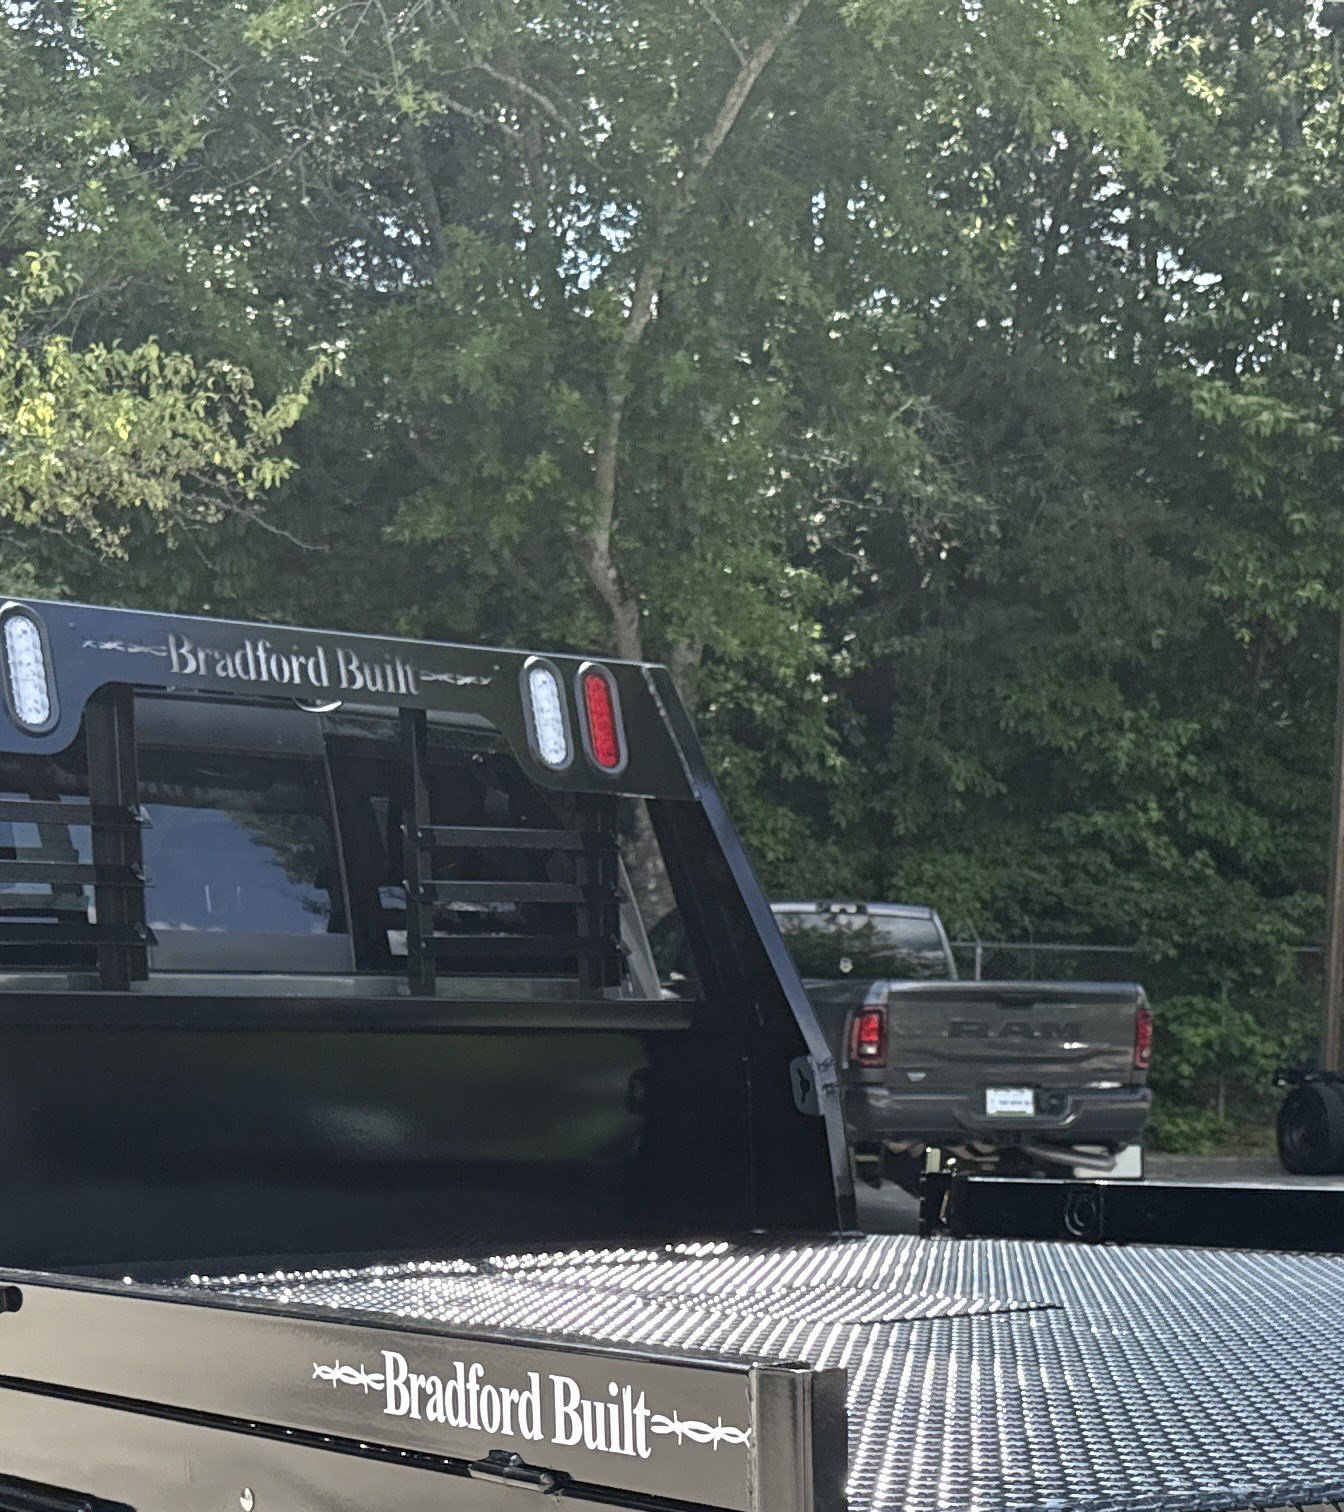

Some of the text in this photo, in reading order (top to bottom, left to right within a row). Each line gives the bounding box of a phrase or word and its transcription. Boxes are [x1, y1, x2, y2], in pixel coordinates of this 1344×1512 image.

[168, 633, 421, 696] Bradford Built
[949, 1021, 1083, 1039] RAM
[380, 1349, 652, 1459] Bradford Built
